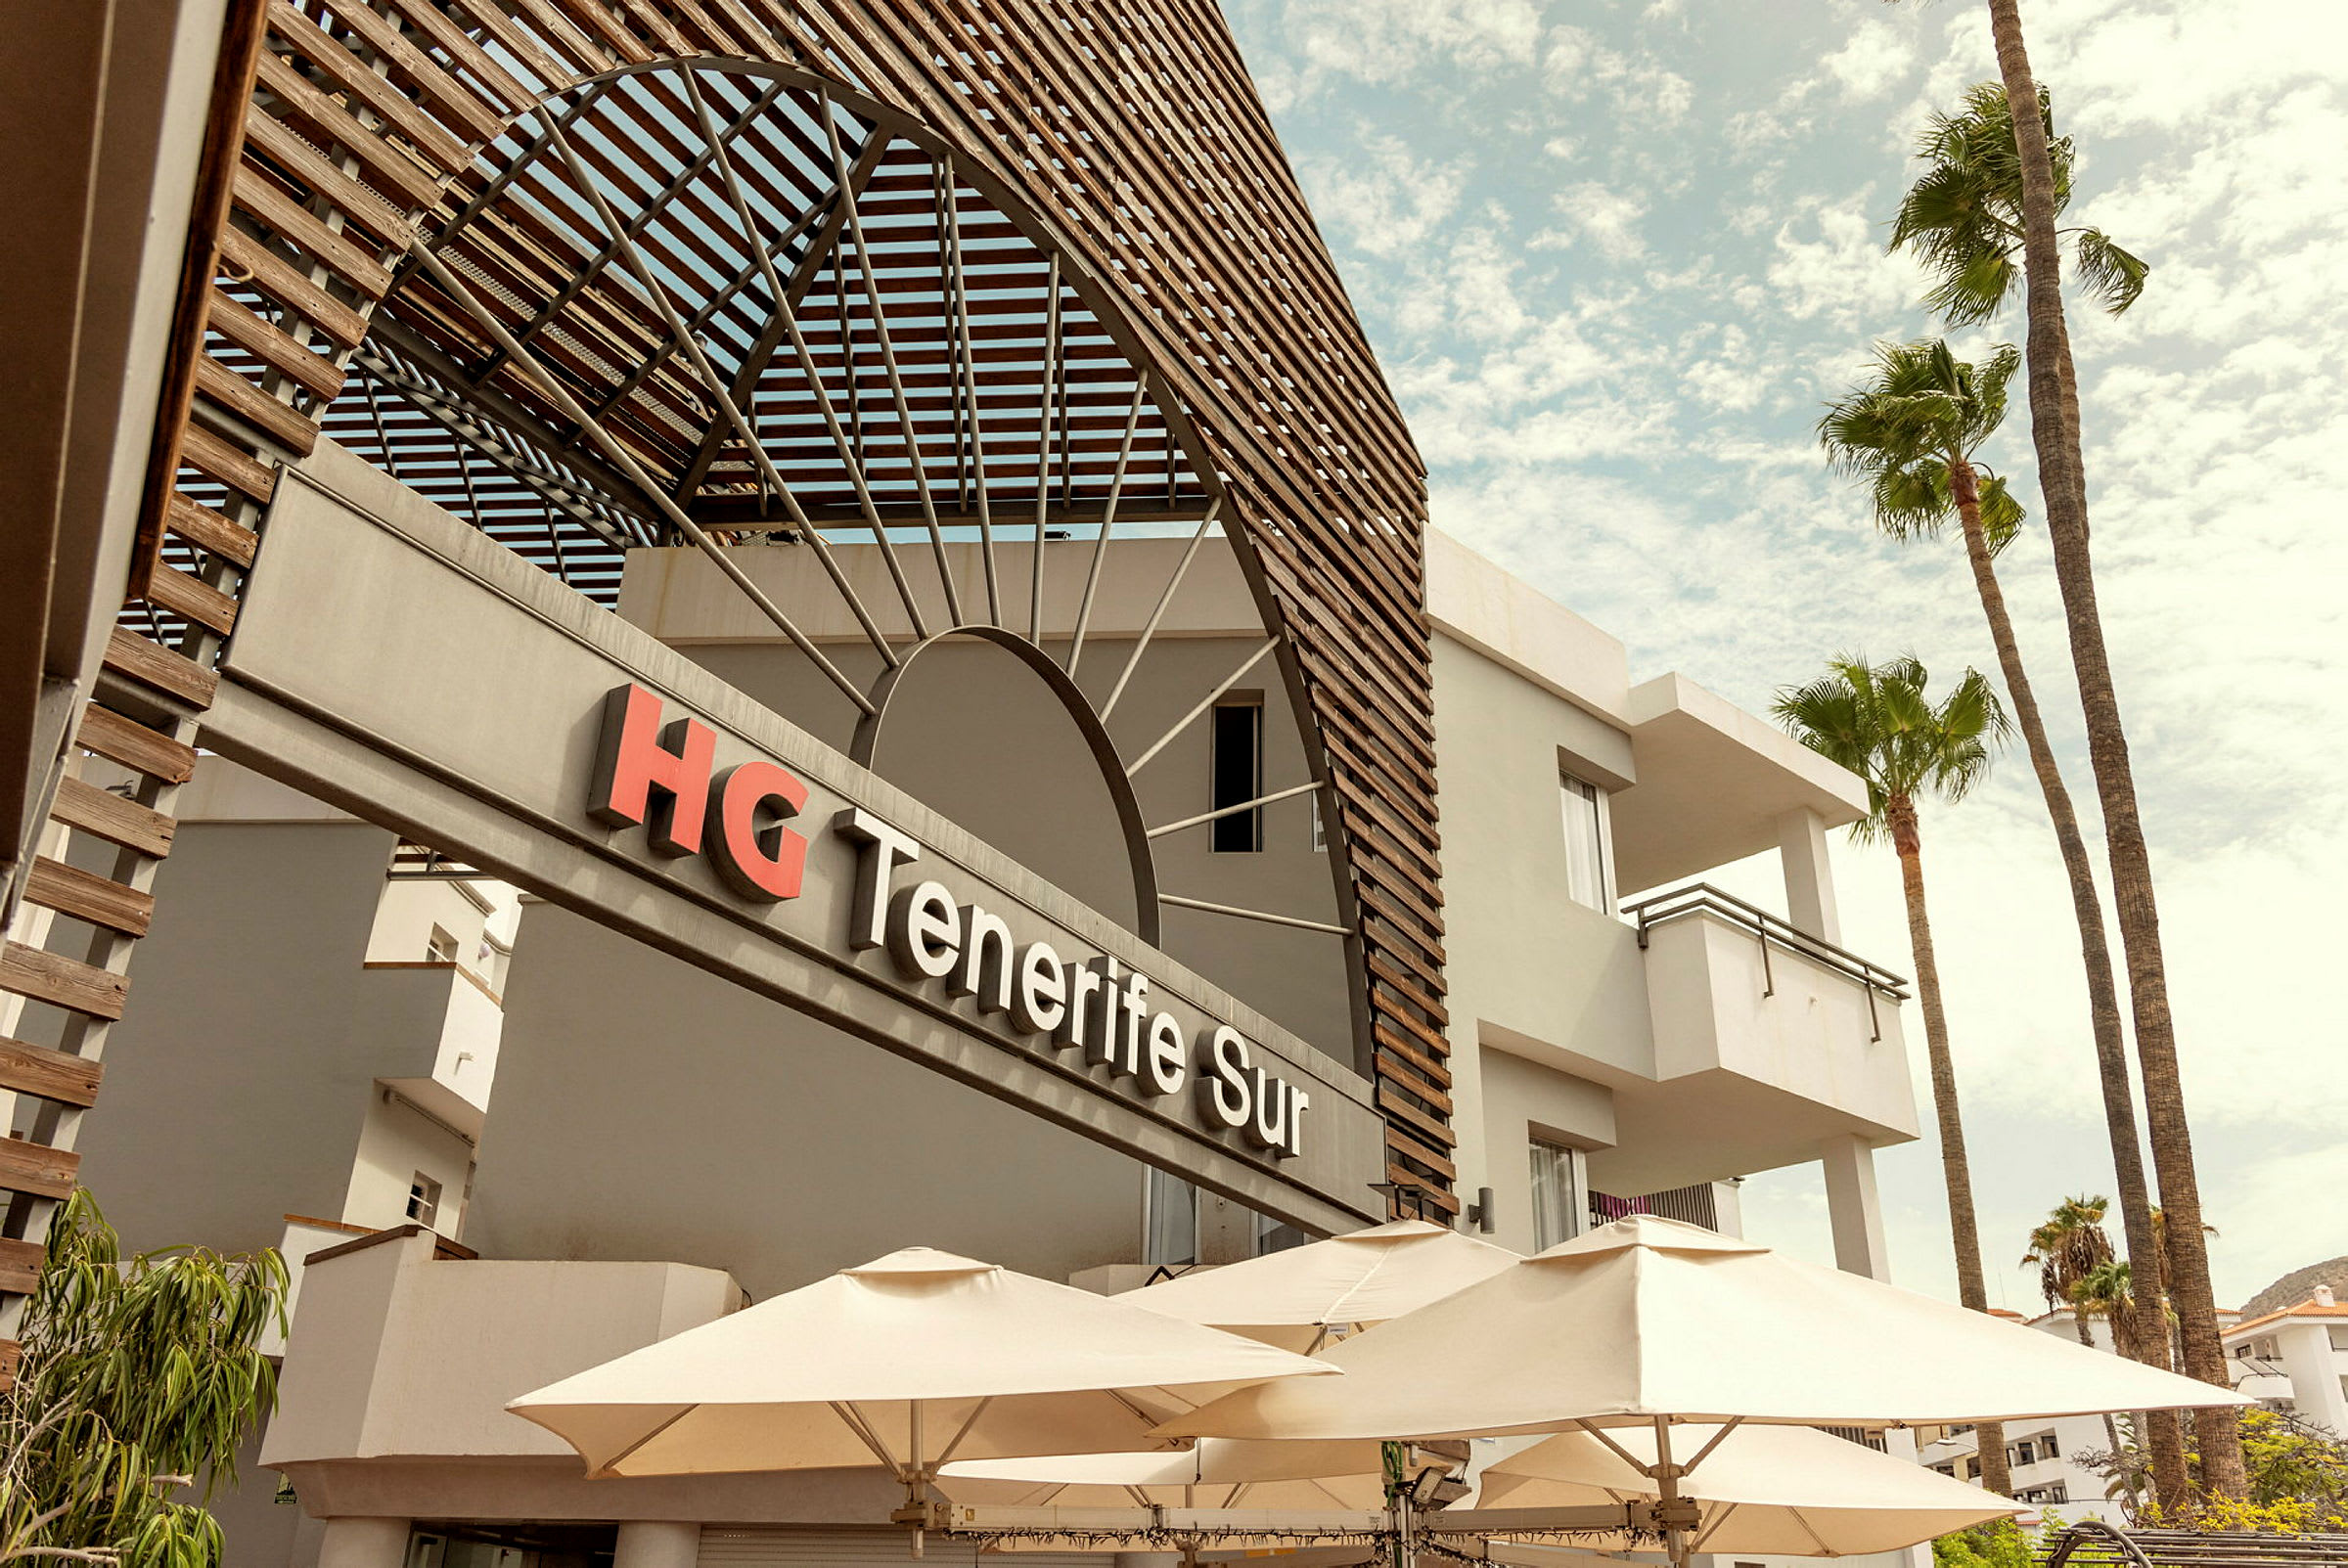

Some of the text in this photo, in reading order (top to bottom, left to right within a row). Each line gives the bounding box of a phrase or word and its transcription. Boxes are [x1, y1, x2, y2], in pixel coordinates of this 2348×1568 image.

[609, 683, 1310, 1158] HG Tenerife Sur
